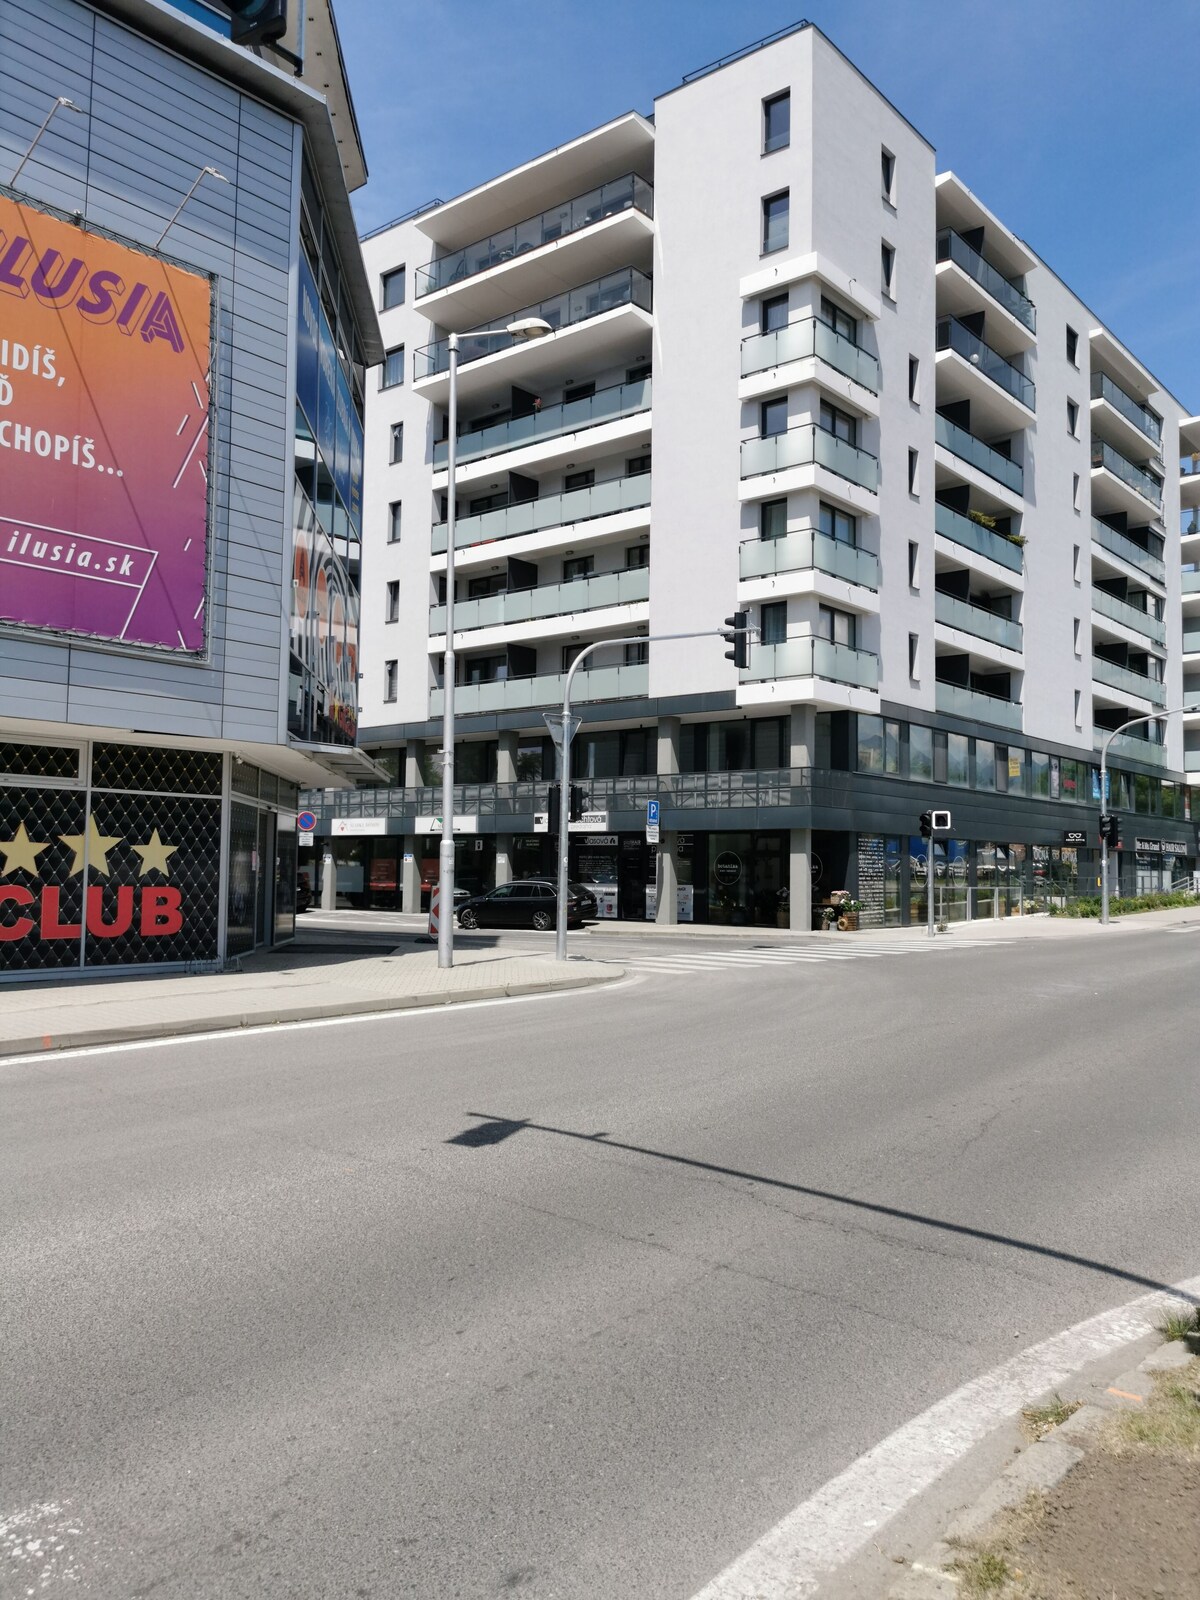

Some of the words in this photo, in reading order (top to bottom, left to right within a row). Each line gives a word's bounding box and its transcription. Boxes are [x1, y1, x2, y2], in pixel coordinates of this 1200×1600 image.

[0, 229, 184, 354] LUSIA
[7, 530, 134, 576] ilusia.sk
[0, 885, 183, 942] CLUB
